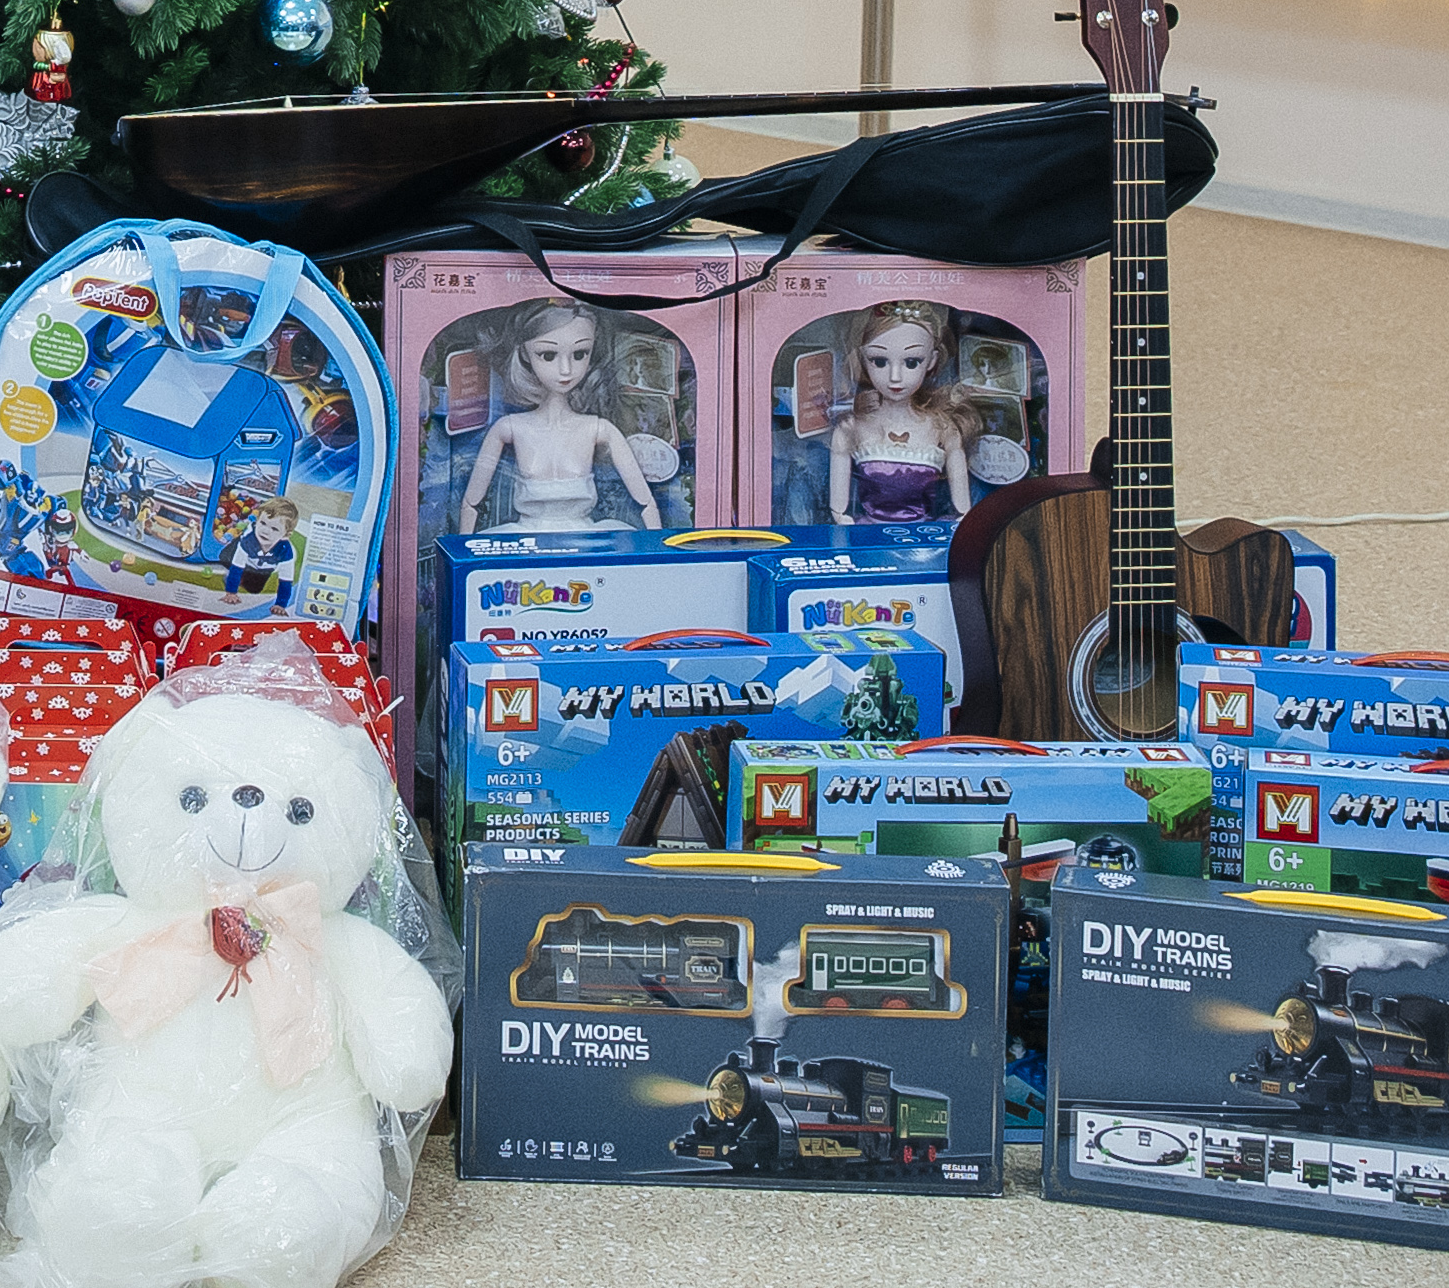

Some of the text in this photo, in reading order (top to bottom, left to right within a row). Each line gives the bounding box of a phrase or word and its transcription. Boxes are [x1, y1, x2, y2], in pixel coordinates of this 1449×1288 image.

[81, 282, 150, 312] PopTent
[6, 382, 14, 394] 2
[465, 538, 536, 549] 6in1
[780, 555, 851, 567] 6in1
[558, 680, 777, 721] MY WORLD
[1274, 696, 1344, 733] MY
[497, 741, 531, 766] 6+
[1210, 744, 1245, 769] 6+
[487, 772, 542, 786] MG2113
[823, 775, 1014, 805] MY WORLD
[487, 792, 513, 804] 554
[486, 811, 610, 826] SEASONAL SERIES
[1329, 793, 1398, 829] MY
[486, 827, 561, 841] PRODUCTS
[504, 848, 565, 861] DIY
[1268, 847, 1304, 872] 6+
[826, 904, 935, 919] SPRAY & LIGHT & MUSIC
[1082, 920, 1153, 960] DIY
[1156, 928, 1231, 952] MODEL
[1082, 956, 1231, 980] TRAIN MODEL SERIES
[1152, 946, 1233, 970] TRAINS
[1081, 969, 1191, 992] SPRAY & LIGHT & MUSIC
[501, 1020, 572, 1057] DIY
[575, 1023, 649, 1042] MODEL
[571, 1042, 650, 1061] TRAINS
